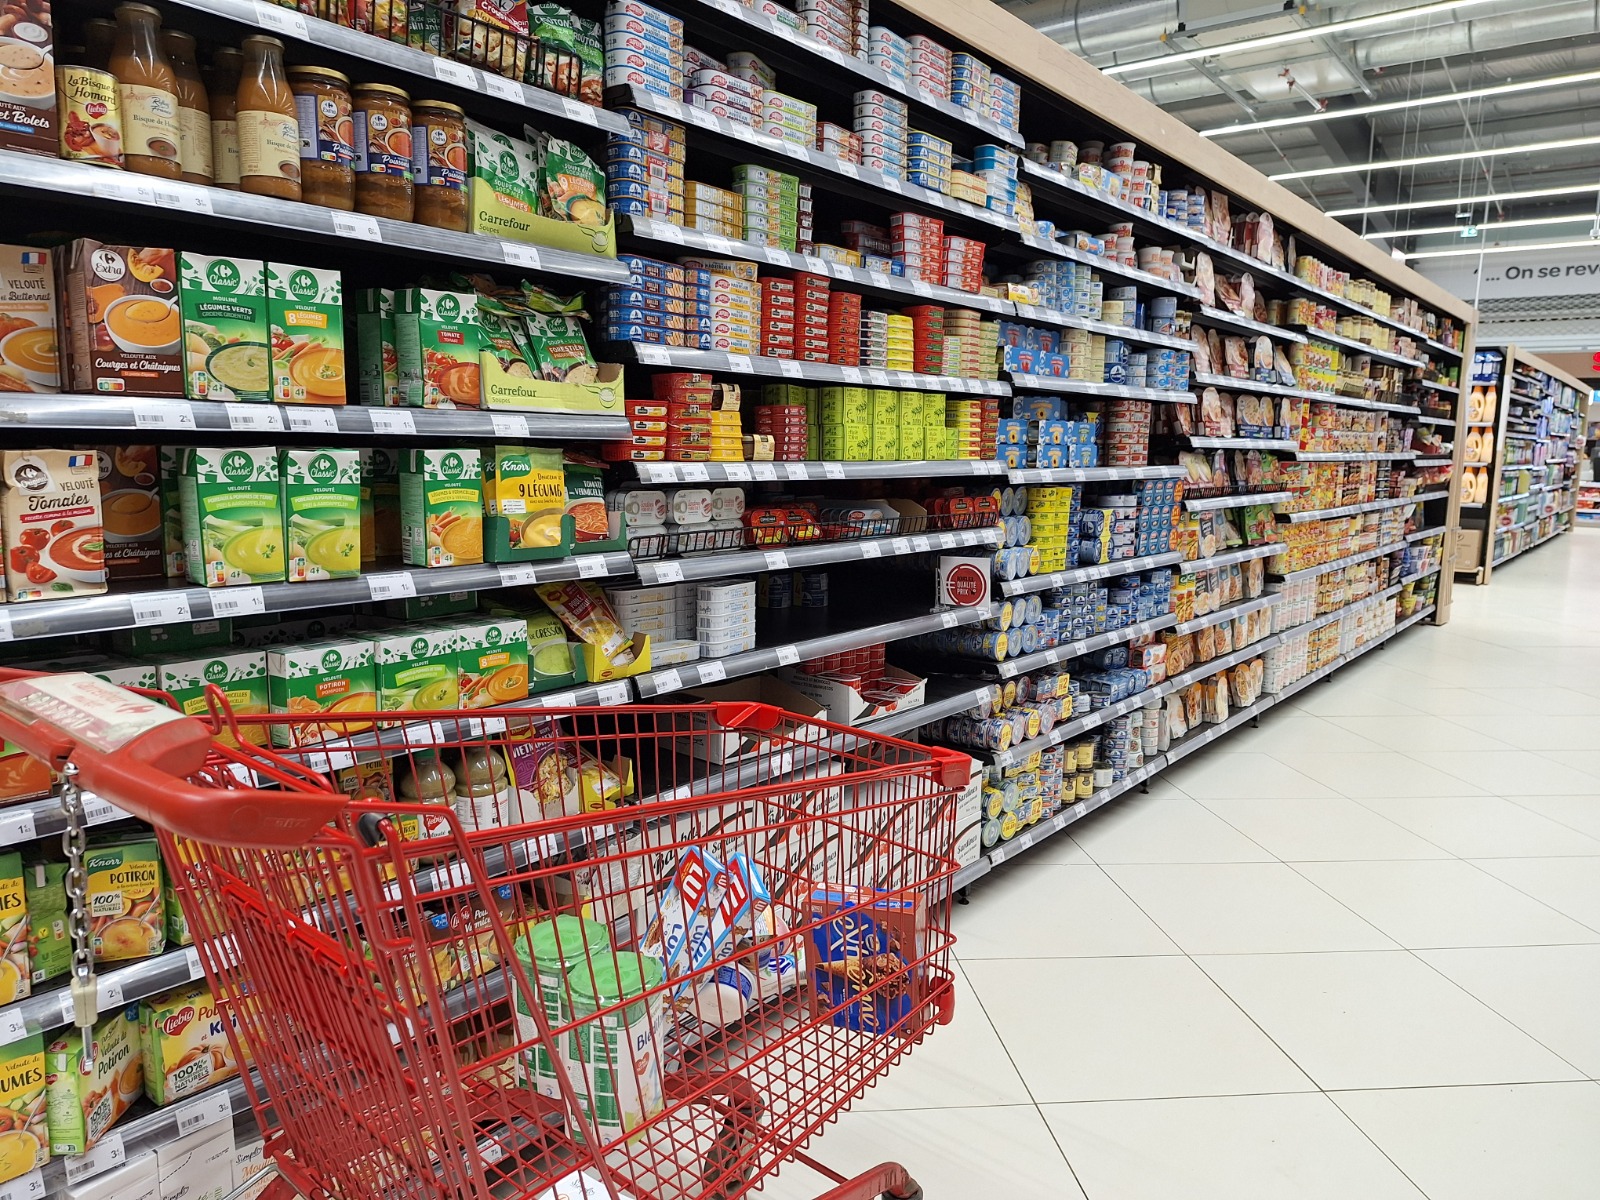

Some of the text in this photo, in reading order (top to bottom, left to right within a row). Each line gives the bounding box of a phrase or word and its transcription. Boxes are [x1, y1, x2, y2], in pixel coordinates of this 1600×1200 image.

[68, 75, 78, 86] La
[79, 76, 110, 91] Bisque
[70, 86, 116, 105] Homard
[87, 104, 107, 114] Liebig
[12, 110, 50, 129] Bolets
[133, 113, 156, 125] Bisque
[479, 210, 531, 231] Carrefour
[95, 263, 122, 275] Extra
[1505, 266, 1533, 280] On
[1537, 266, 1561, 279] se
[1565, 263, 1600, 277] rev
[8, 278, 46, 290] VELOUTÉ
[209, 274, 239, 287] Classic
[8, 291, 52, 302] Butternut
[291, 284, 318, 296] Classic
[199, 303, 253, 316] LÉGUMES VERTS
[95, 357, 181, 374] Courges et Châtaignes
[490, 385, 537, 398] Carrefour
[223, 465, 252, 476] Classic
[500, 459, 530, 471] Knorr
[310, 467, 336, 479] Classic
[59, 477, 95, 492] VELOUTÉ
[518, 483, 525, 498] 9
[28, 493, 90, 512] Tomates
[319, 680, 346, 691] POTIRON
[88, 857, 122, 868] Knorr
[110, 869, 156, 885] POTIRON
[93, 893, 121, 905] 100%
[165, 1011, 194, 1034] Liebig
[98, 1044, 129, 1080] Potiron
[172, 1059, 204, 1082] 100%
[174, 1070, 210, 1090] NATURELS
